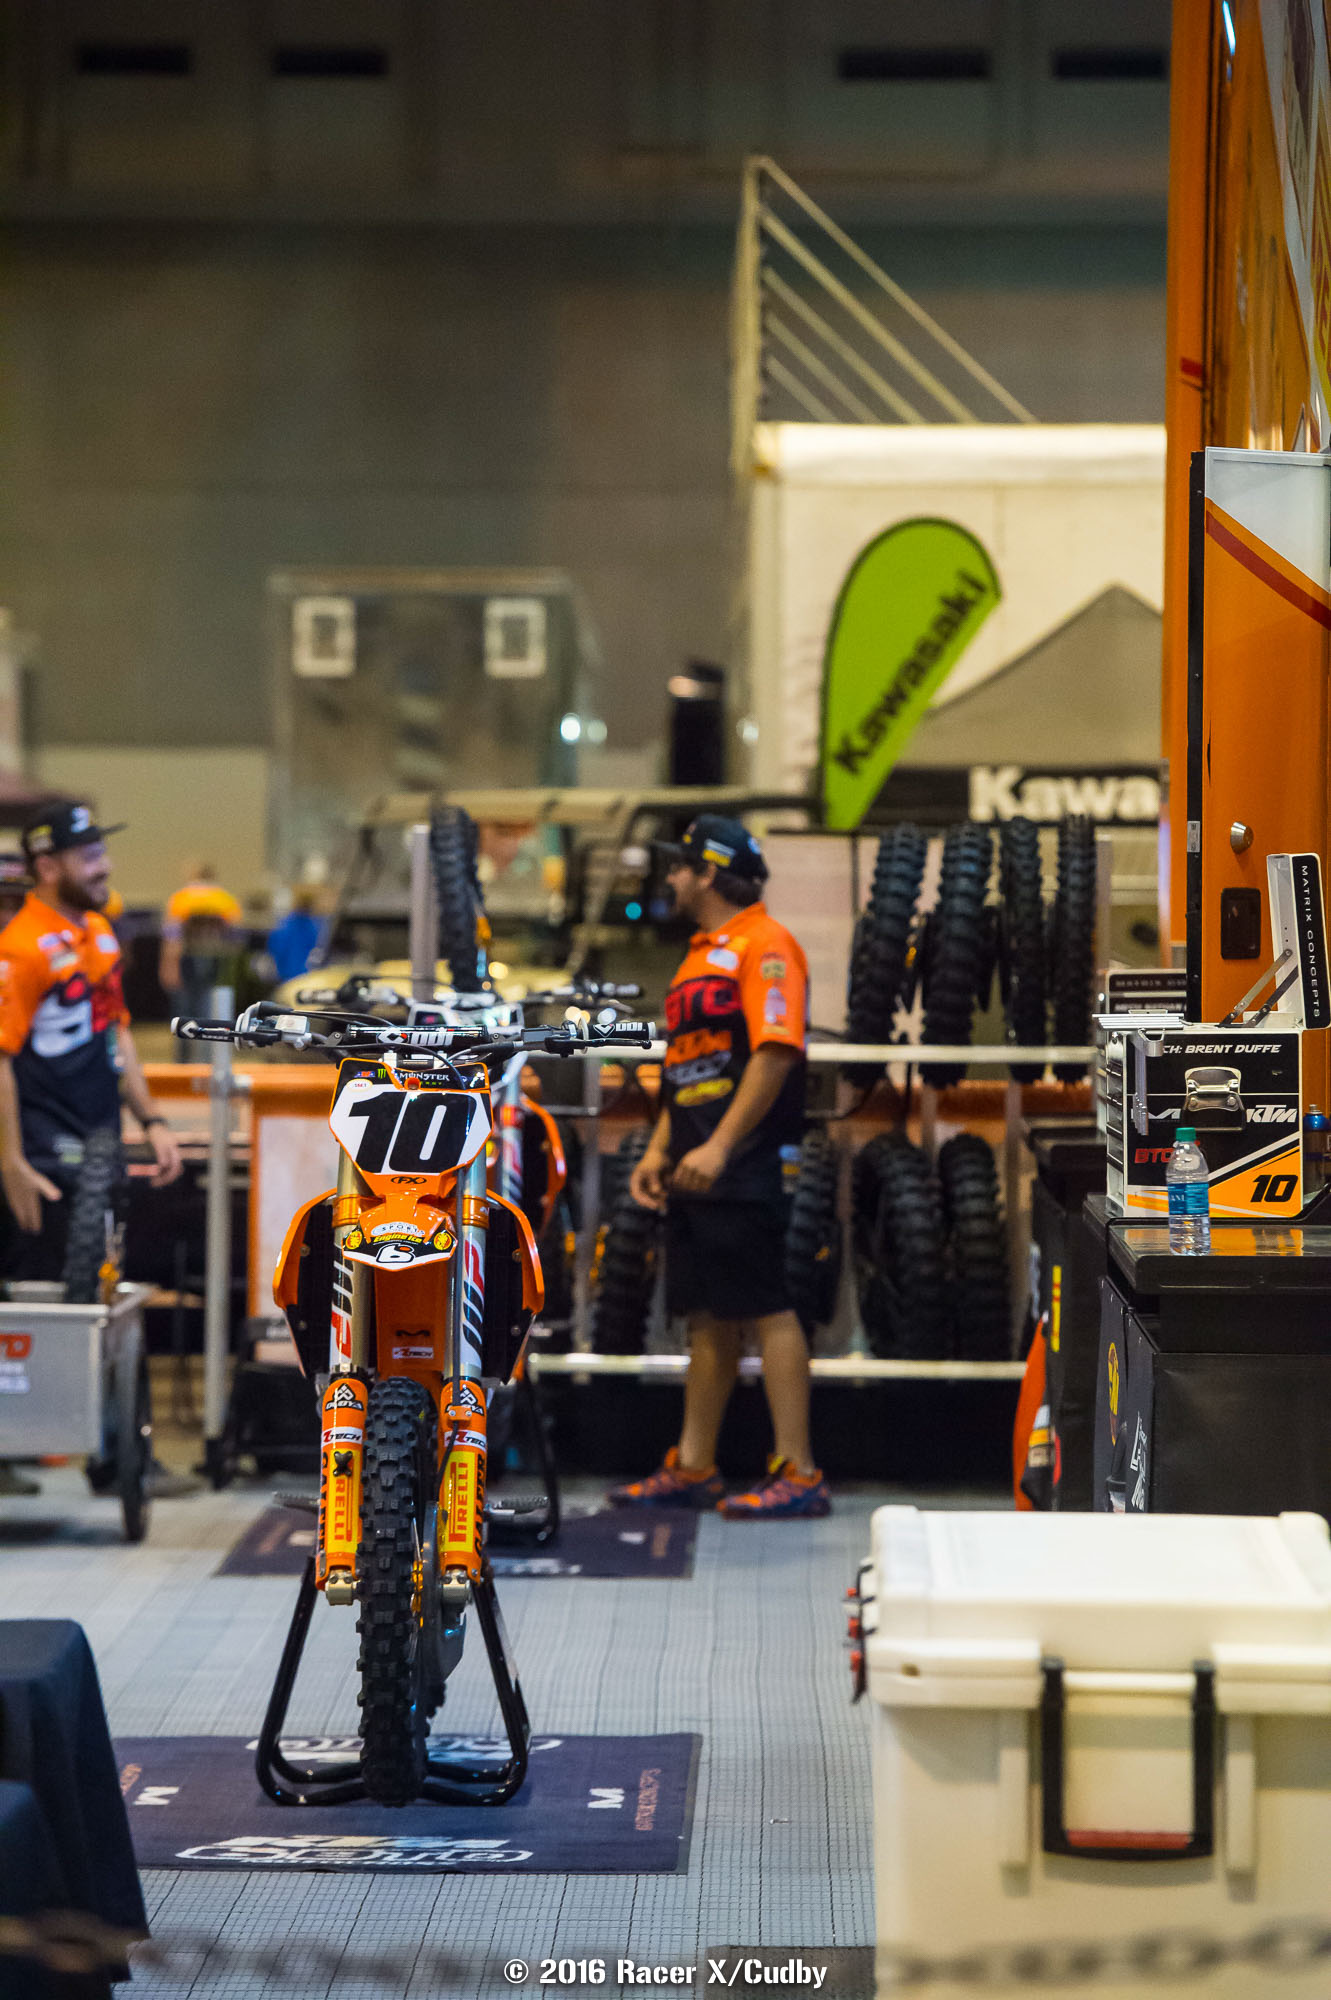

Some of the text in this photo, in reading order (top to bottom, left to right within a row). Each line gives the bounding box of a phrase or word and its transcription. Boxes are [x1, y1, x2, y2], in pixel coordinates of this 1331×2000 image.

[834, 569, 989, 776] Kawasaki
[1301, 865, 1321, 1018] MATRIX CONCEPTS
[399, 1071, 450, 1081] MONSTER
[1185, 1044, 1233, 1054] BRENT
[1234, 1044, 1282, 1054] DUFFE
[348, 1091, 478, 1173] 10
[1246, 1104, 1298, 1123] KTM
[1250, 1174, 1299, 1203] 10
[448, 1461, 468, 1542] PIRELLI
